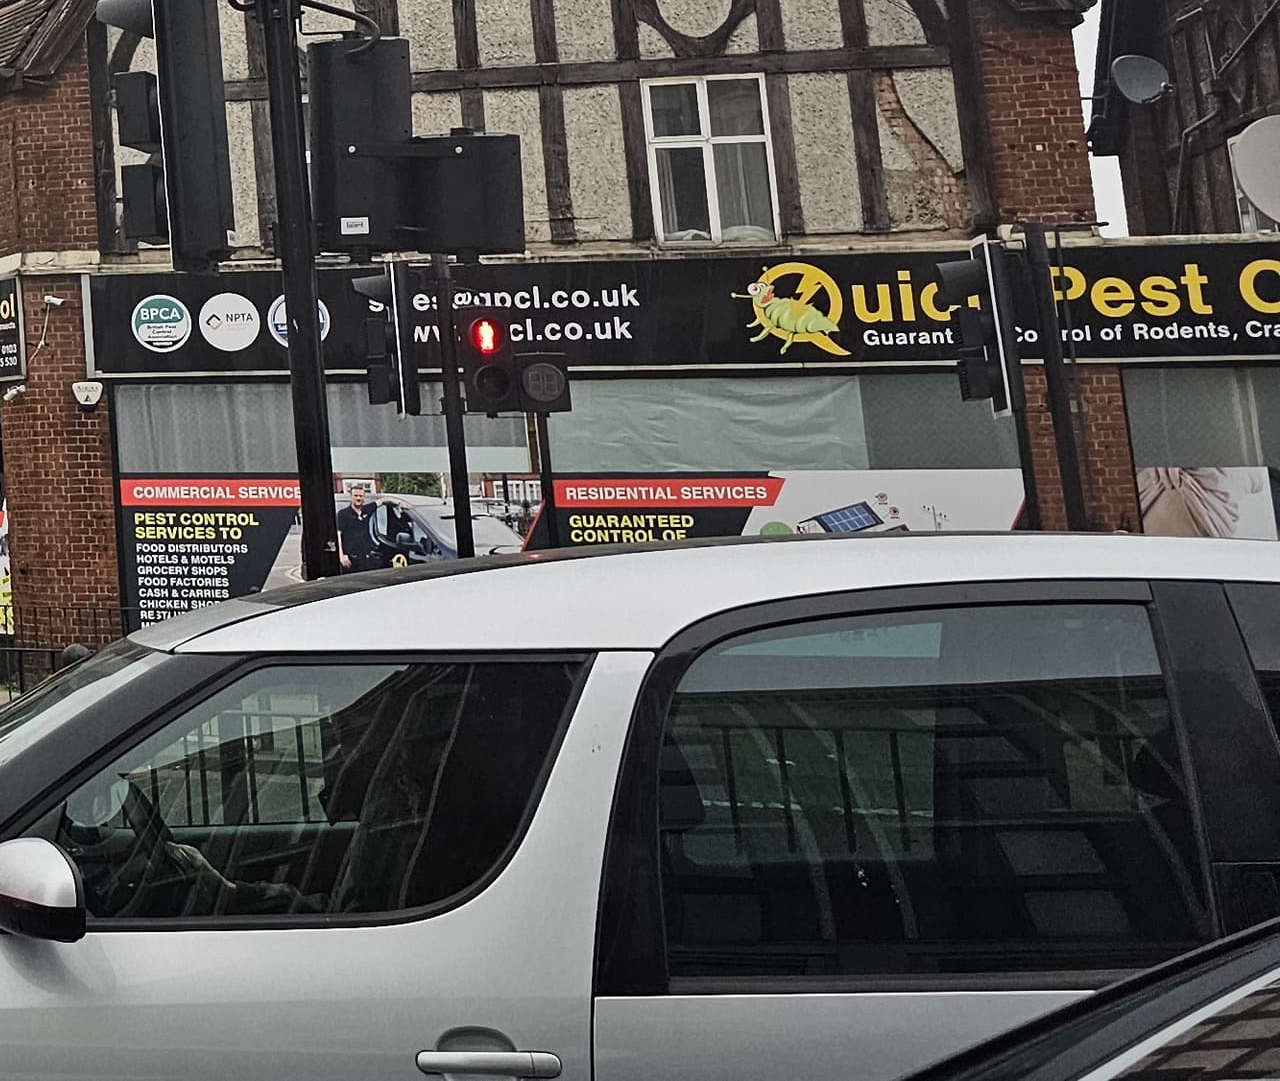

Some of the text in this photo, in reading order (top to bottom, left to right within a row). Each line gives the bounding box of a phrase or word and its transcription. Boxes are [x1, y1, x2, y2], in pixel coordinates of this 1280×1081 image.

[140, 308, 181, 320] BPCA
[753, 262, 980, 356] Quic
[1049, 263, 1214, 318] Pest
[225, 313, 254, 322] NPTA
[863, 327, 955, 346] Guarant
[1100, 323, 1122, 342] of
[1133, 322, 1239, 342] Rodents,
[133, 486, 301, 499] COMMERCIAL SERVICE
[566, 486, 767, 500] RESIDENTIAL SERVICES
[134, 513, 259, 526] PEST CONTROL
[569, 514, 694, 528] GUARANTEED
[135, 527, 242, 540] SERVICES TO
[570, 529, 687, 543] CONTROL OF
[136, 543, 248, 553] FOOD DISTRIBUTORS
[136, 555, 235, 564] HOTELS & MOTELS
[137, 566, 228, 576] GROCERY SHOPS
[138, 577, 229, 587] FOOD FACTORIES
[138, 588, 229, 598] CASH & CARRIES
[140, 600, 188, 609] CHICKEN
